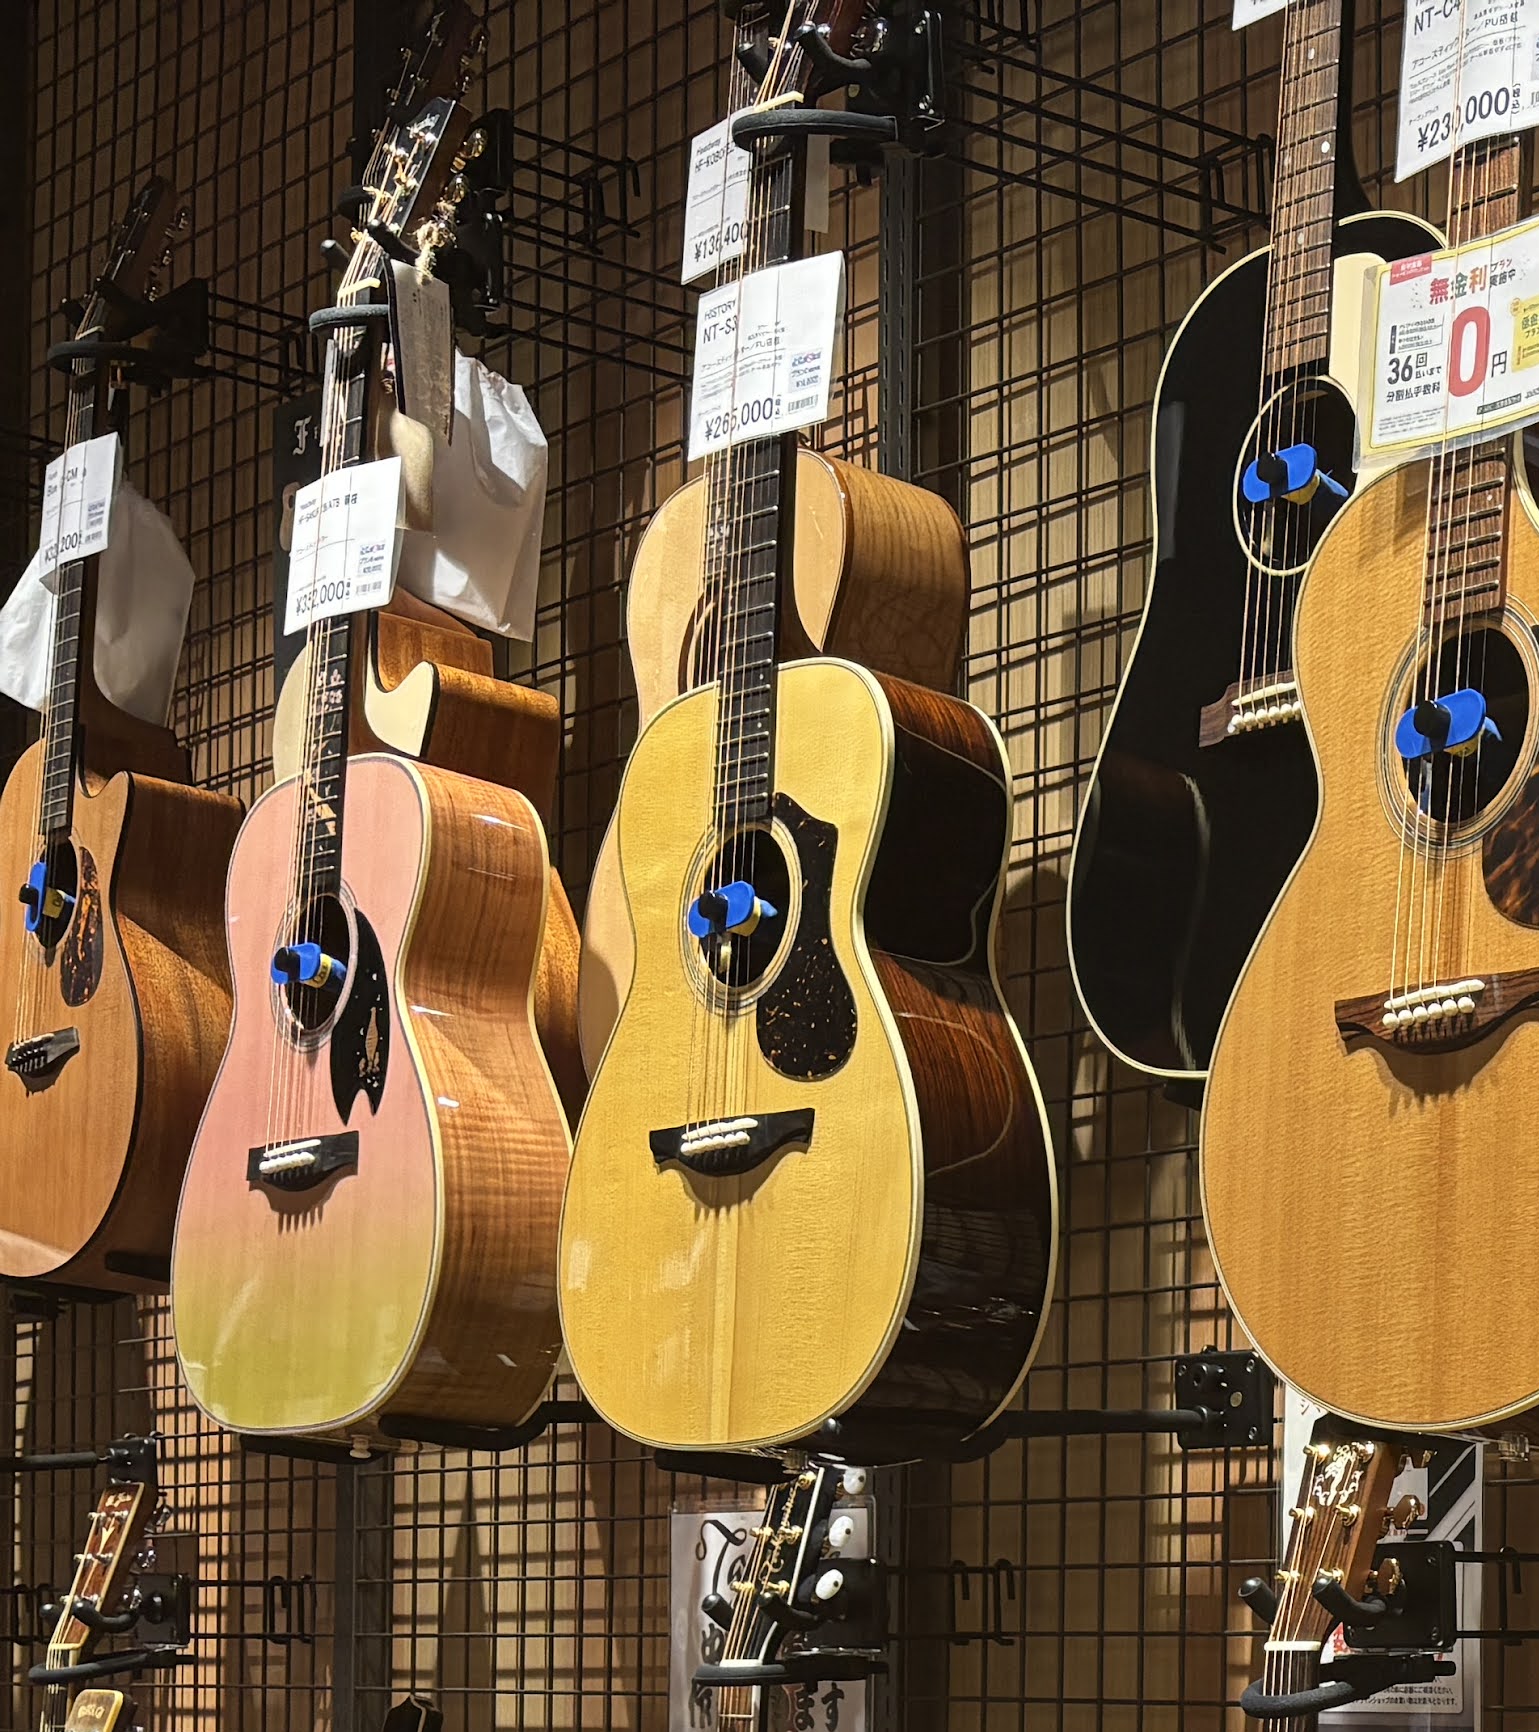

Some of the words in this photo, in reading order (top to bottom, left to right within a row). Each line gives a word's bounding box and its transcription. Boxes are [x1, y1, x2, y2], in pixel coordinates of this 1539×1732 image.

[1429, 264, 1488, 304] 無金利
[1387, 354, 1413, 384] 36
[1448, 306, 1490, 397] 0
[1491, 351, 1508, 378] 円
